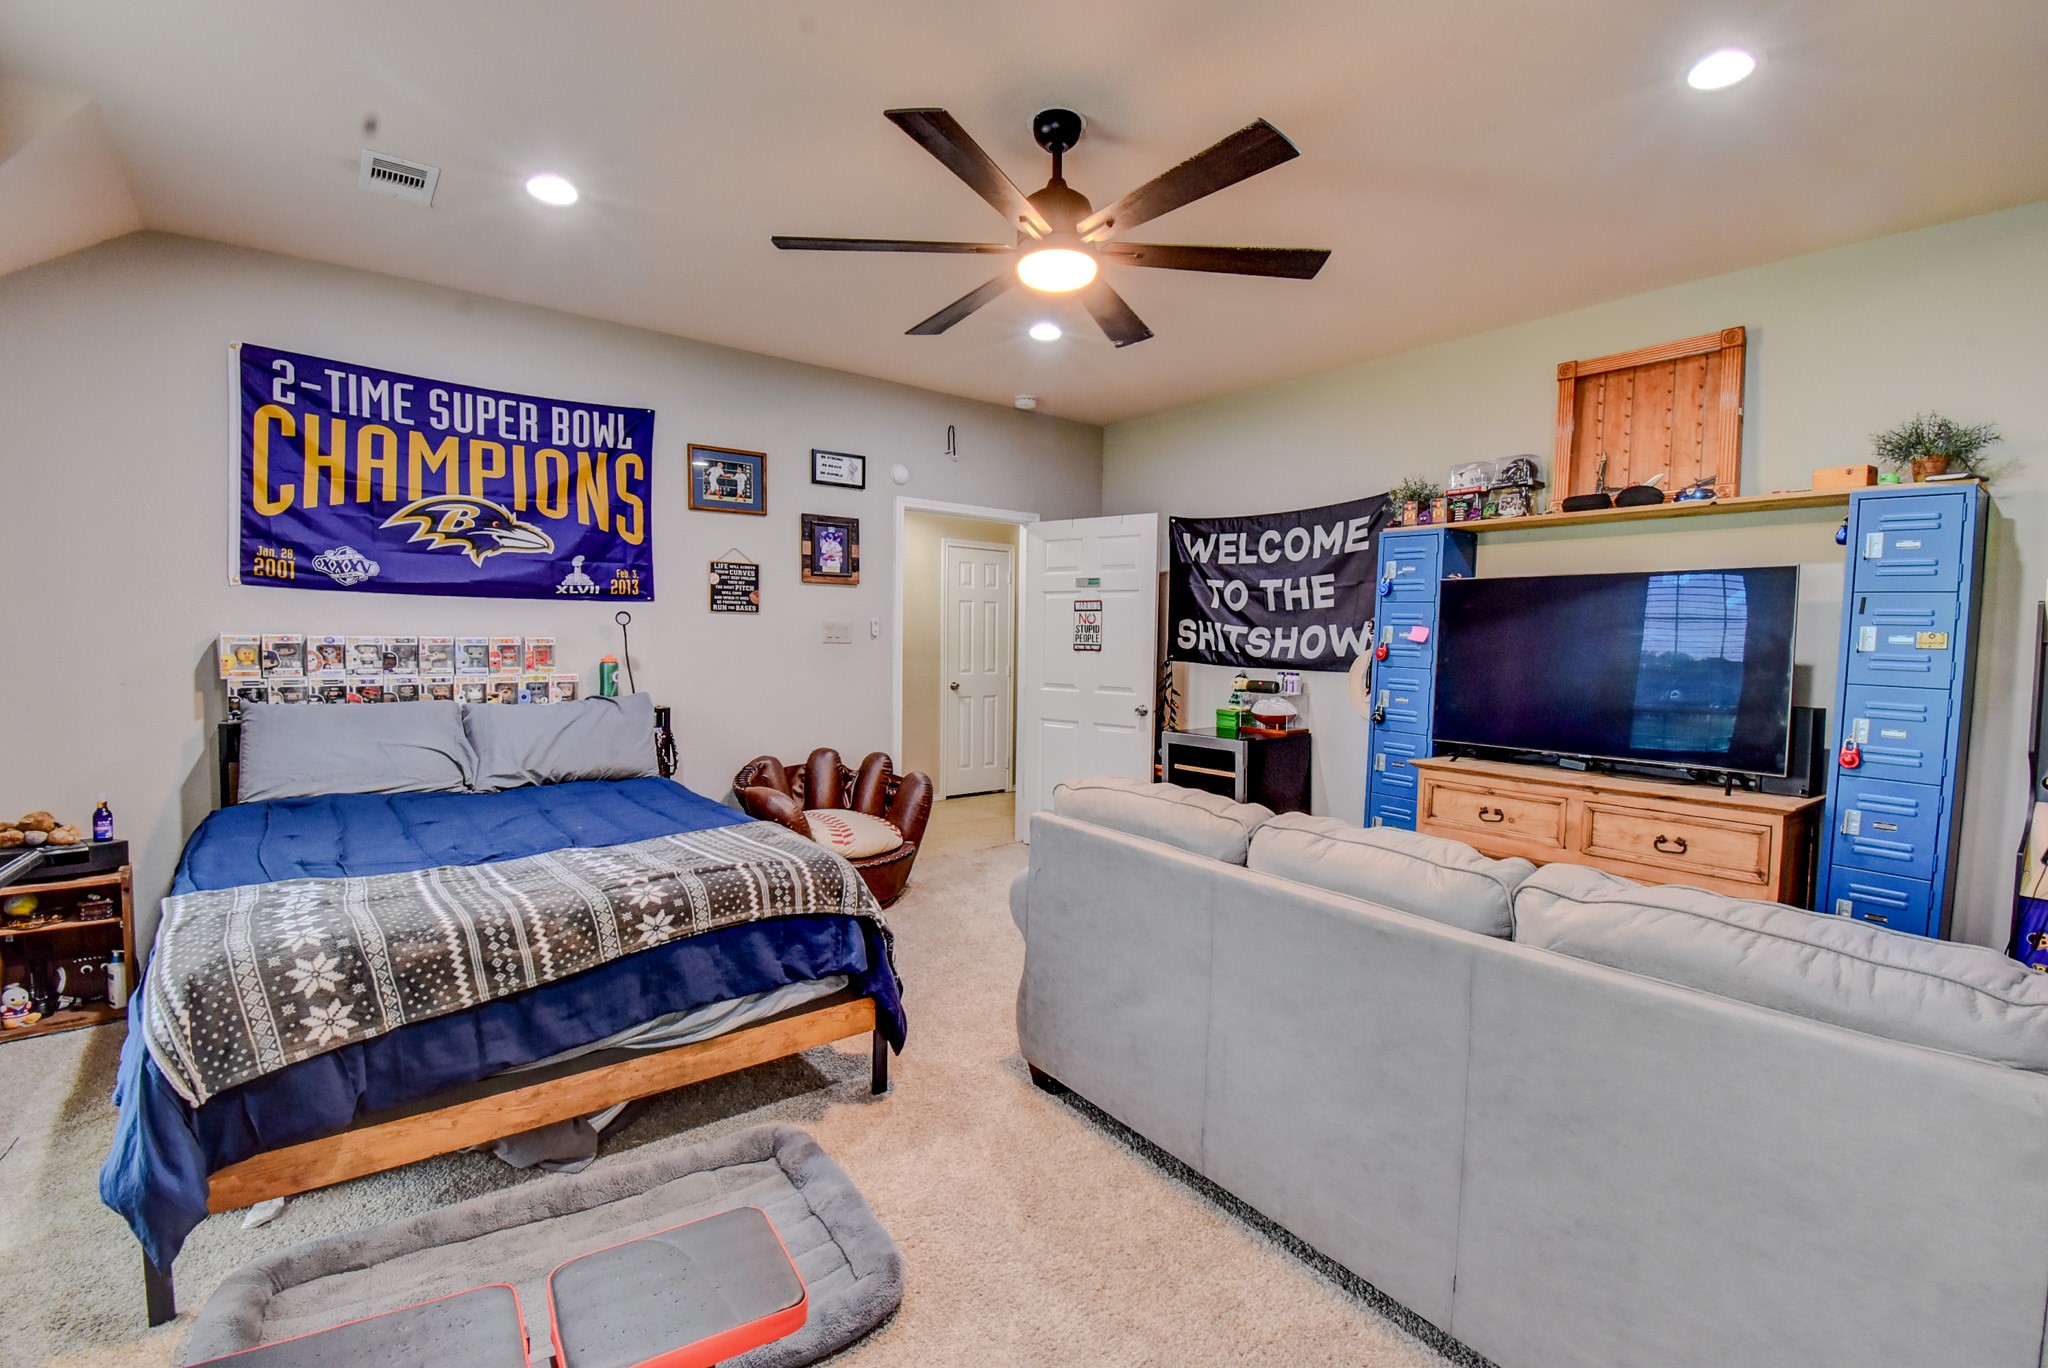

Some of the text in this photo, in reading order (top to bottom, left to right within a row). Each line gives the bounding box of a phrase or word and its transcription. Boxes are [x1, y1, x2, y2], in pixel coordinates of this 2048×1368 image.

[272, 359, 632, 449] 2-TIME SUPER BOWL
[253, 404, 644, 546] CHAMPIONS
[1183, 516, 1371, 564] WELCOME
[256, 545, 278, 557] Jan.
[253, 557, 295, 579] 2001
[616, 569, 631, 578] Feb.
[555, 585, 600, 594] XLVII
[610, 579, 639, 595] 2013
[1206, 573, 1335, 612] TO THE
[1078, 613, 1096, 624] NO
[1075, 625, 1100, 633] STUPID
[1074, 634, 1100, 643] PEOPLE
[1177, 618, 1373, 659] SHITSHOW
